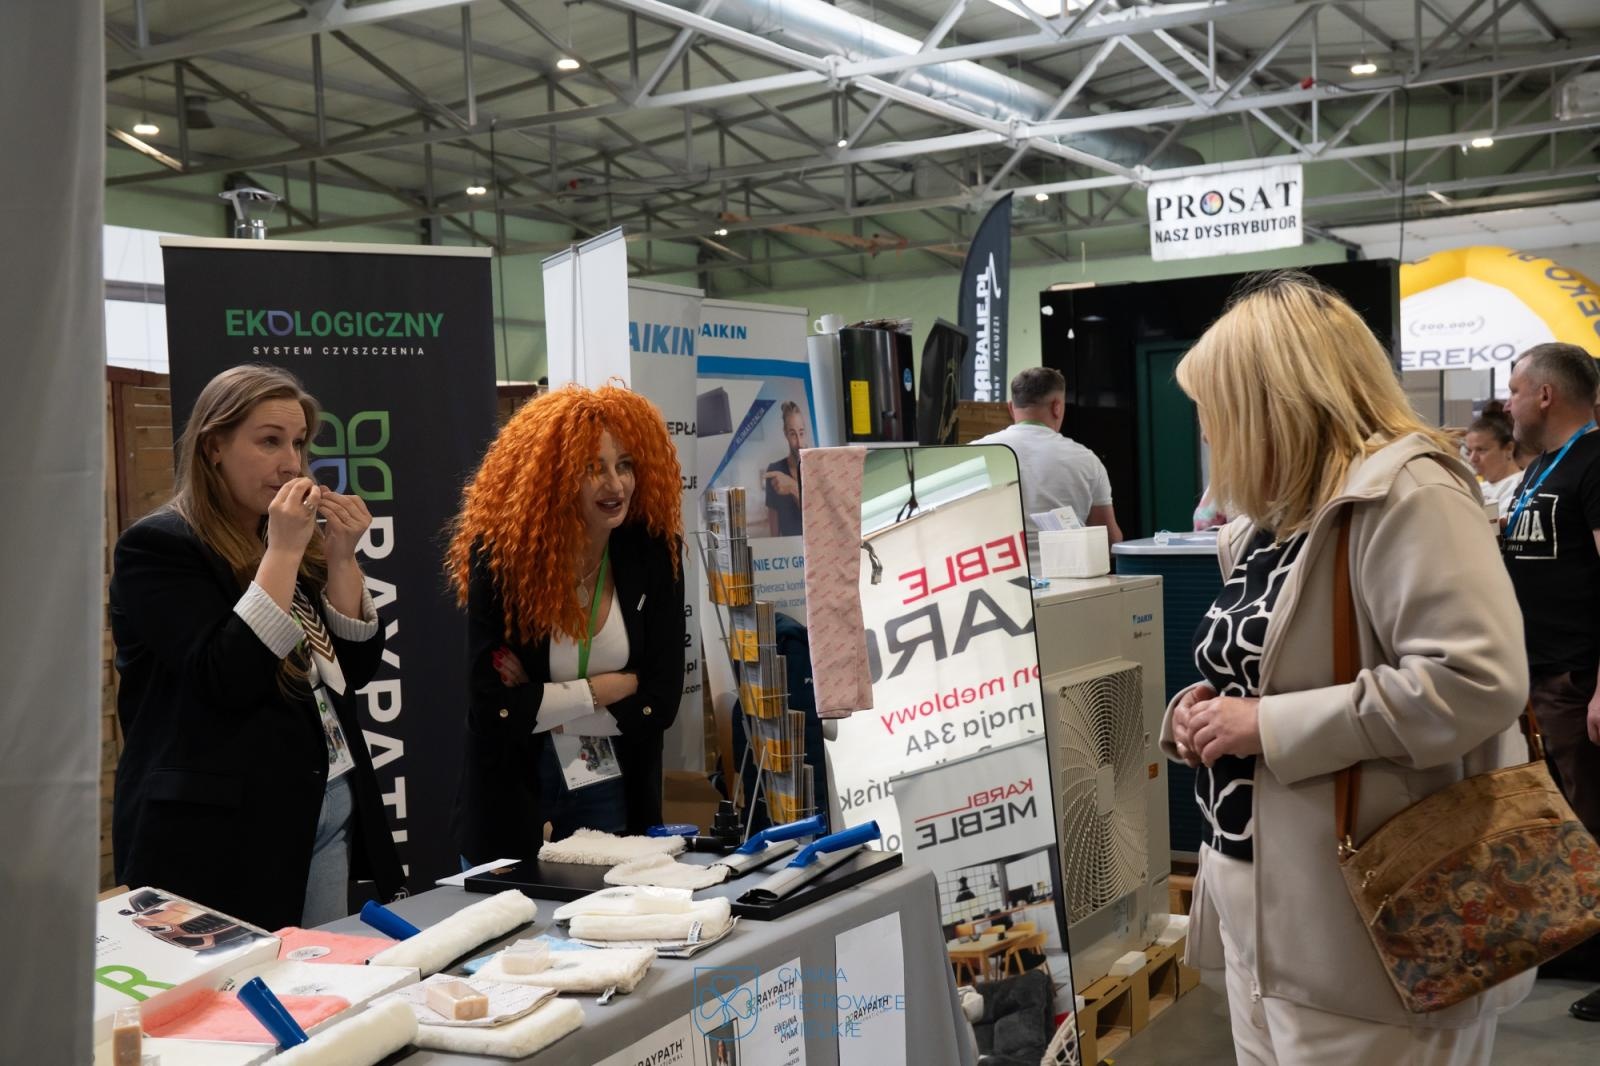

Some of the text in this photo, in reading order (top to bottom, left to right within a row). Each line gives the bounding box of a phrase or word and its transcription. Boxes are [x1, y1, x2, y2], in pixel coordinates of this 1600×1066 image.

[1154, 180, 1298, 222] PROSAT
[1155, 215, 1297, 244] NASZ DYSTRYBUTOR
[225, 308, 445, 338] EKOLOGICZNY
[698, 322, 748, 340] AIKIN
[252, 346, 425, 356] SYSTEM CZYSZCZENIA
[629, 320, 695, 357] AIKIN
[993, 316, 1001, 362] JACUZZI
[754, 555, 805, 571] NIE CZY GR
[756, 582, 785, 598] ybierasz
[354, 515, 410, 878] RAPAT
[756, 978, 796, 1005] RAYPATH
[853, 995, 889, 1021] RAYPATH
